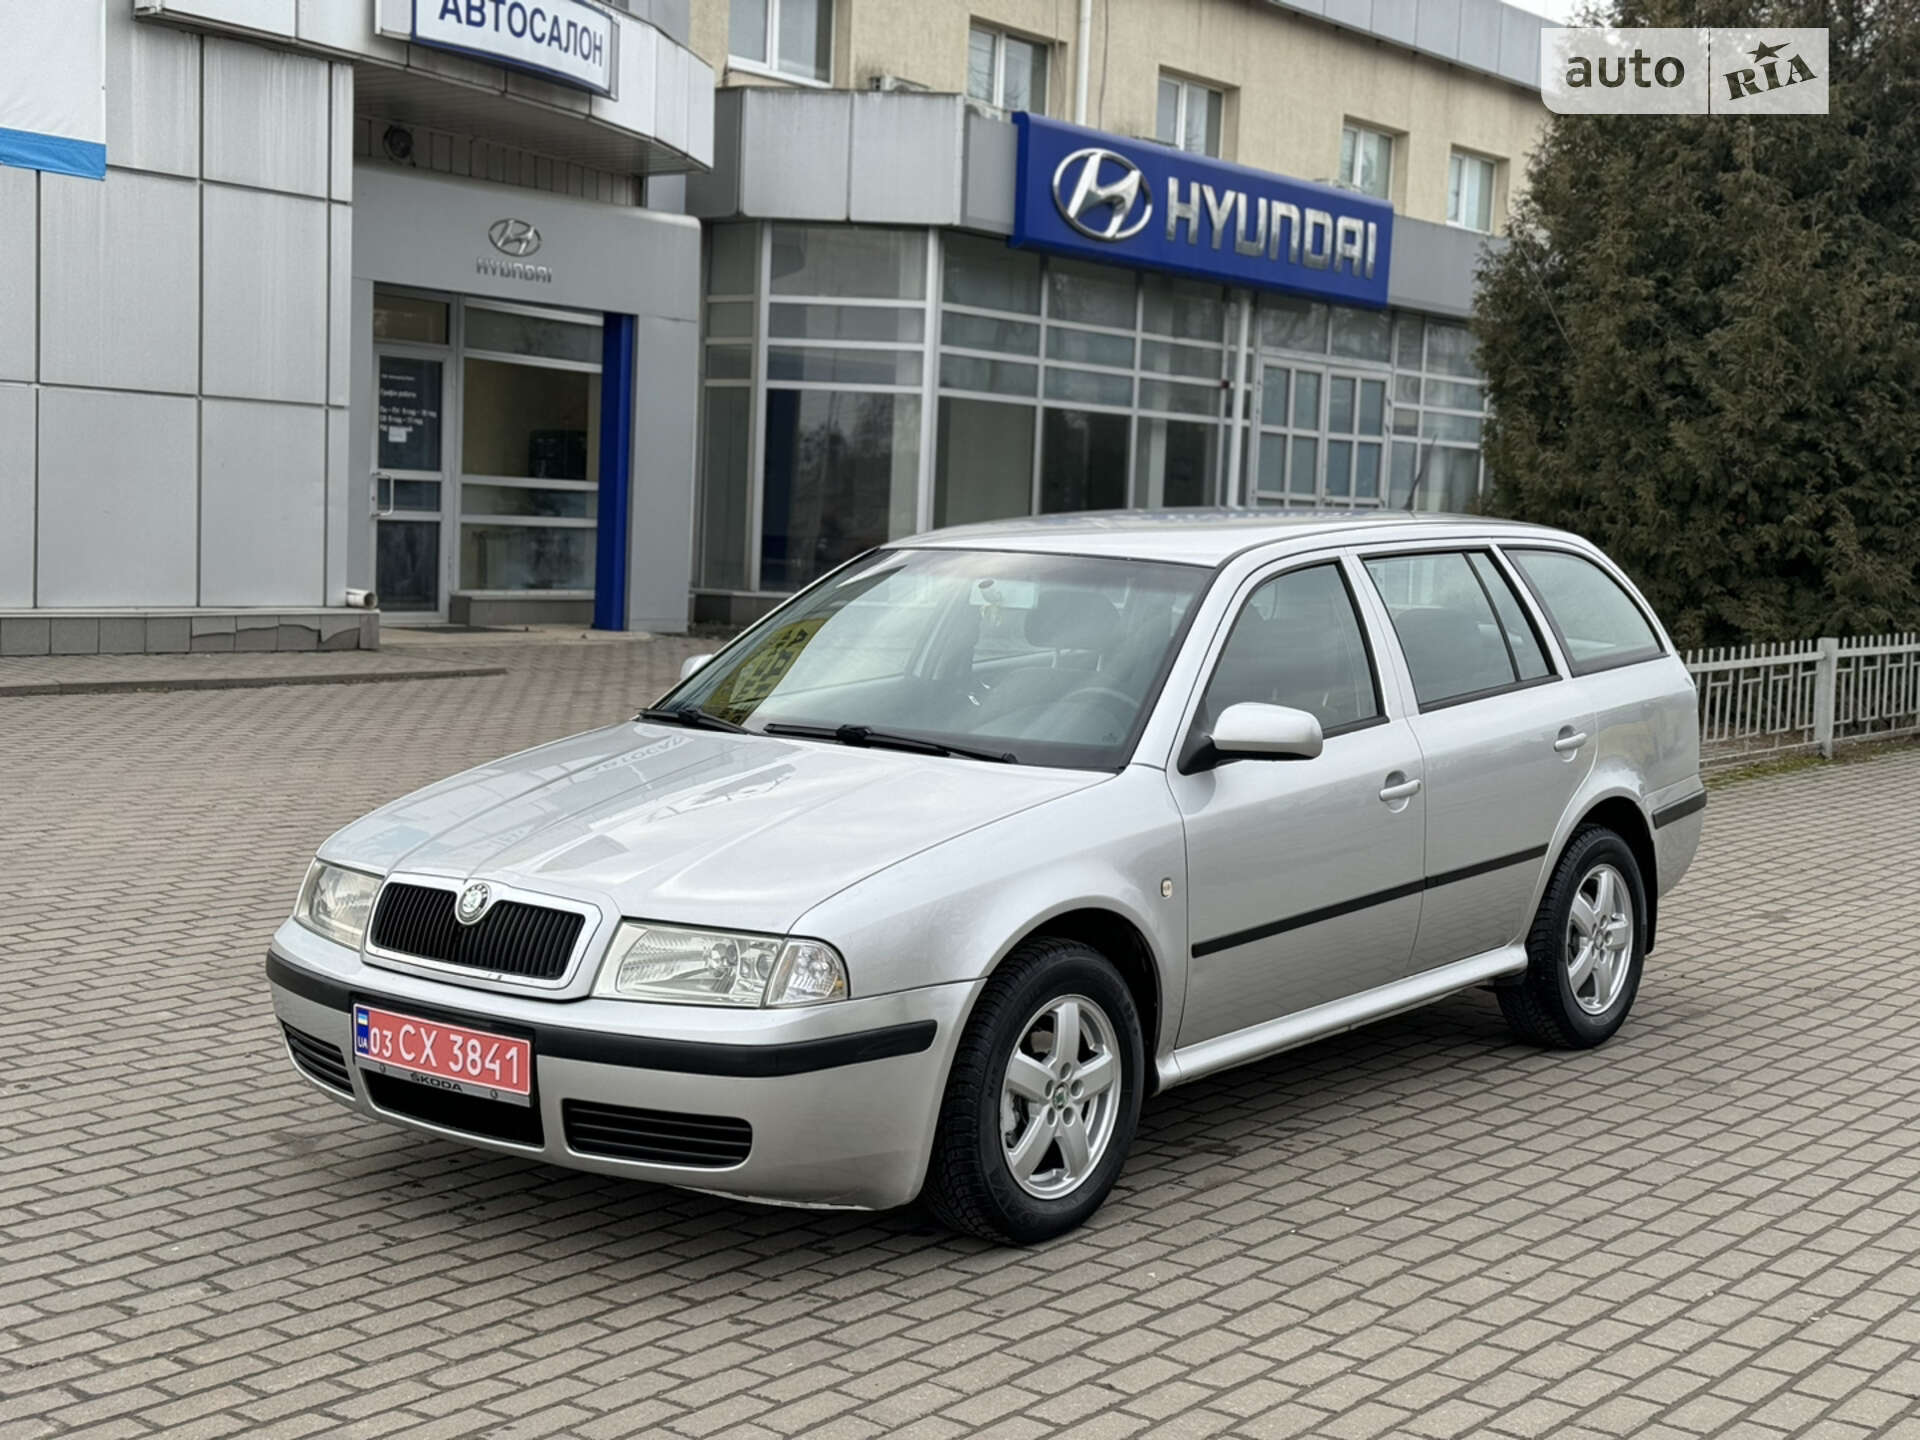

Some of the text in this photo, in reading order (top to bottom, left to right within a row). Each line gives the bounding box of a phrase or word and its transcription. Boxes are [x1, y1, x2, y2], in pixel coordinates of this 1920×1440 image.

[438, 0, 603, 67] АВТОСАЛОН
[1166, 177, 1376, 279] HYUNDAI
[476, 256, 552, 283] HYUNDAI
[358, 1036, 368, 1049] UA
[370, 1023, 518, 1085] 03 CX 3841
